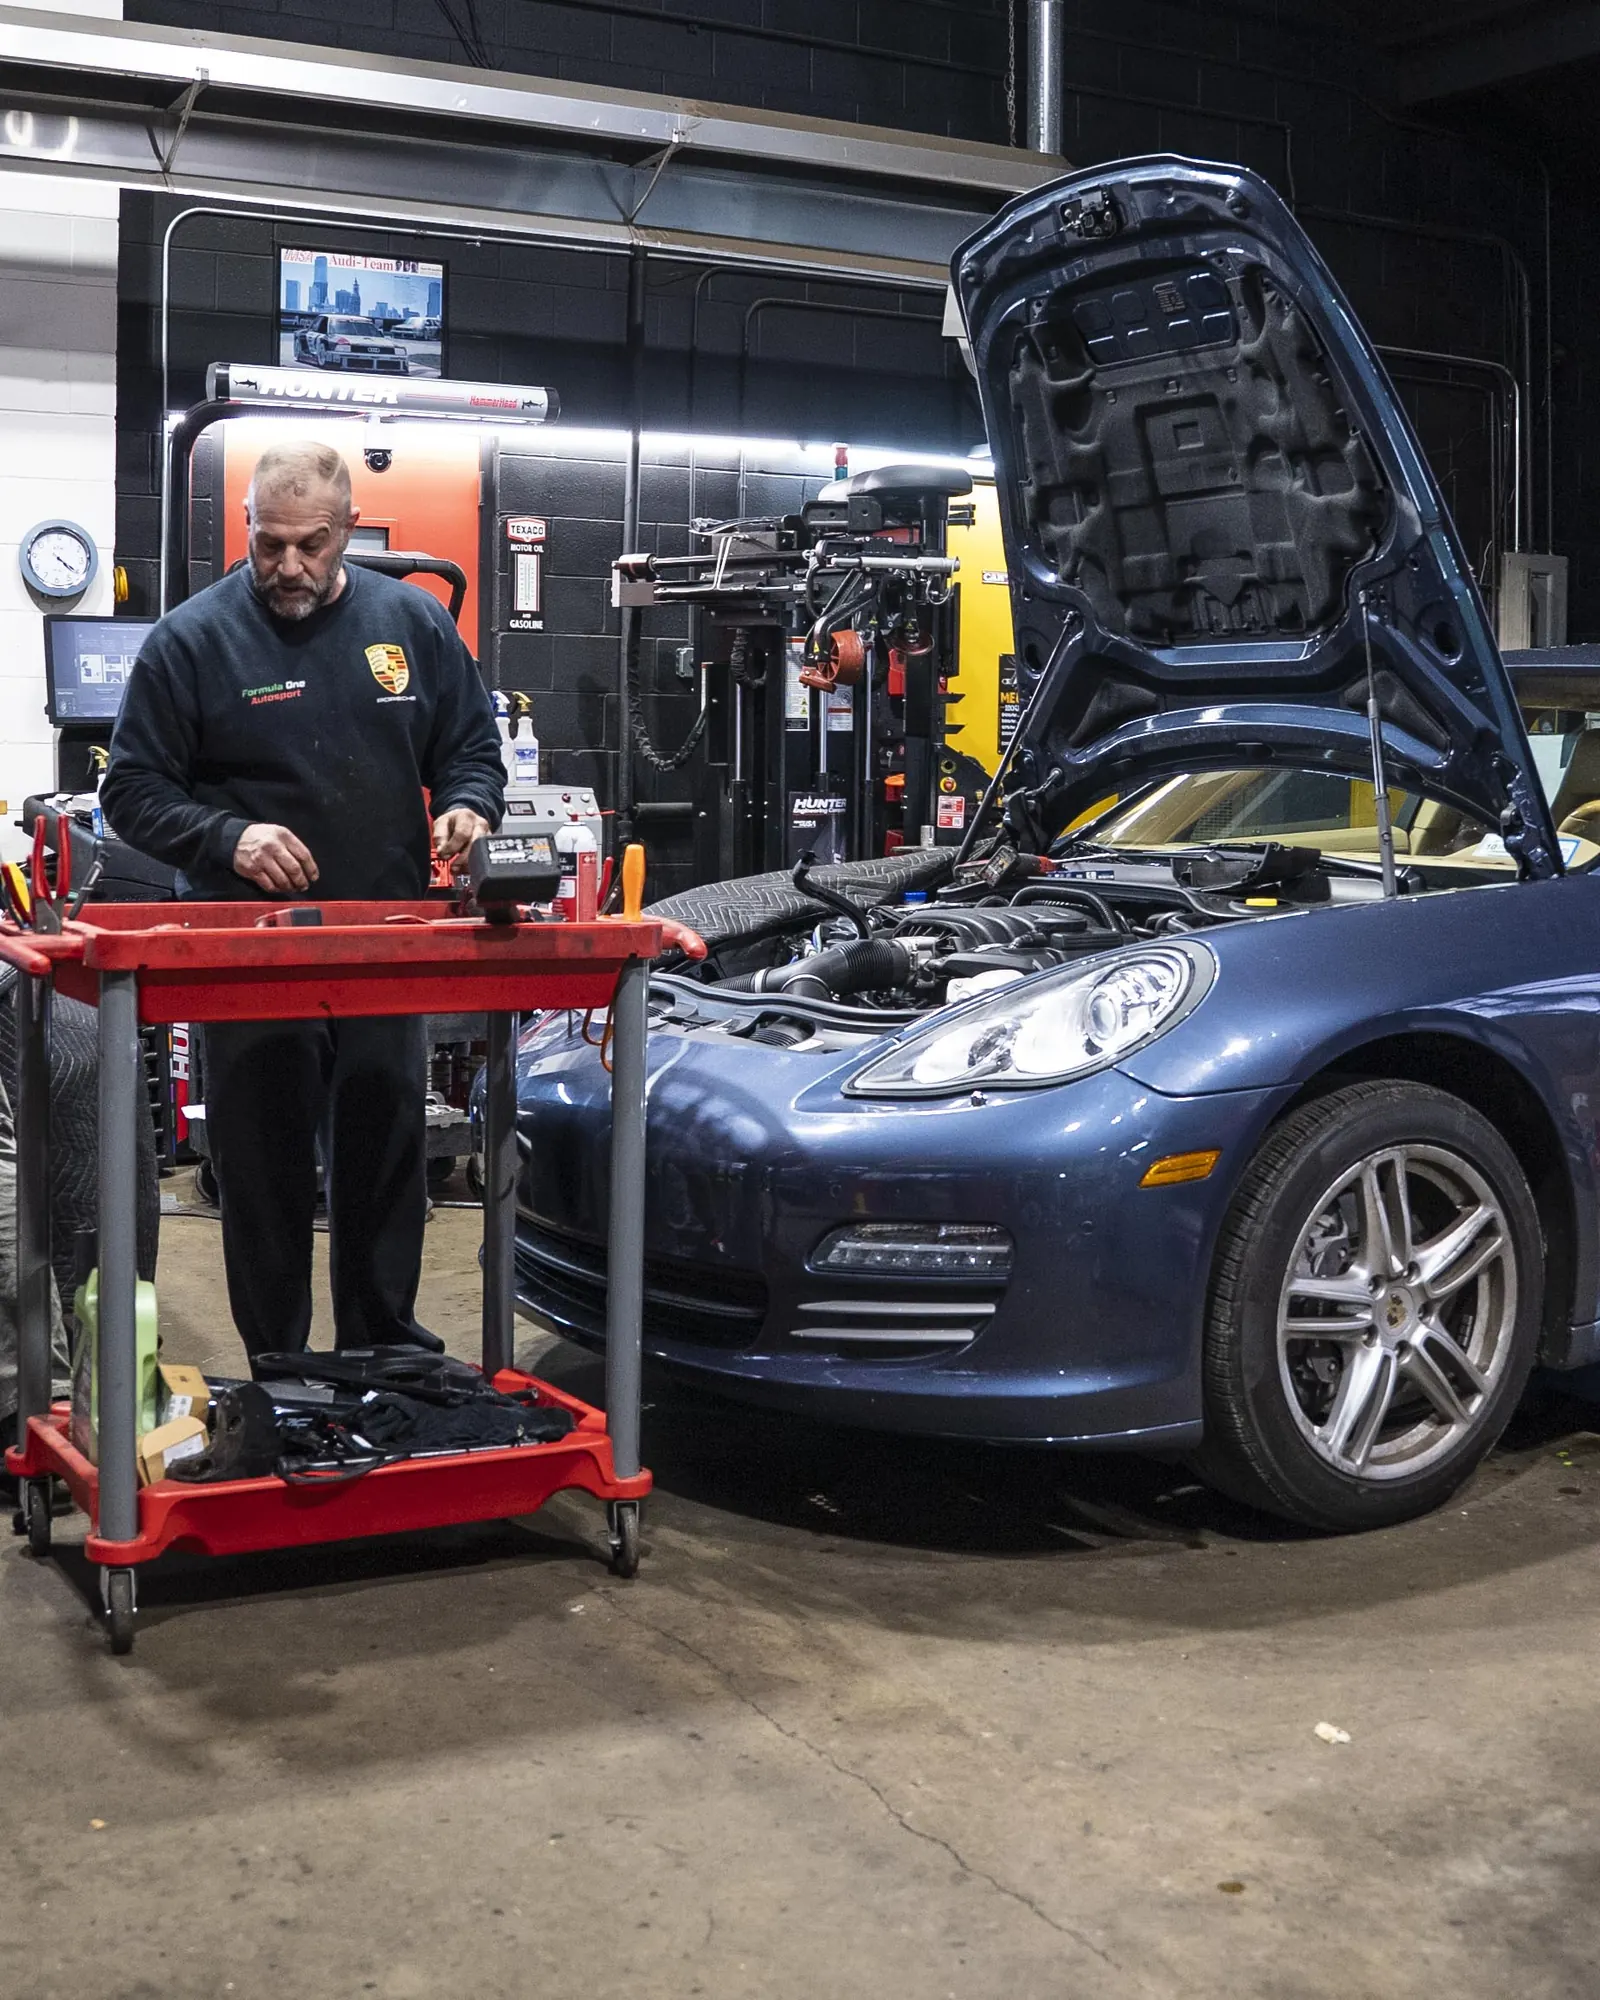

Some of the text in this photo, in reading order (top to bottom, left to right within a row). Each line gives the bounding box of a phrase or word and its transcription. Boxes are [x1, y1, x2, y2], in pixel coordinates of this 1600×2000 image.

[329, 255, 394, 271] Audi-Team
[258, 380, 399, 405] HUNTER
[511, 525, 544, 535] TEXACO
[510, 544, 544, 553] MOTOR OIL
[509, 620, 544, 630] GASOLINE
[242, 680, 306, 698] Formula One
[250, 689, 302, 705] Autosport
[794, 796, 847, 808] HUNTER
